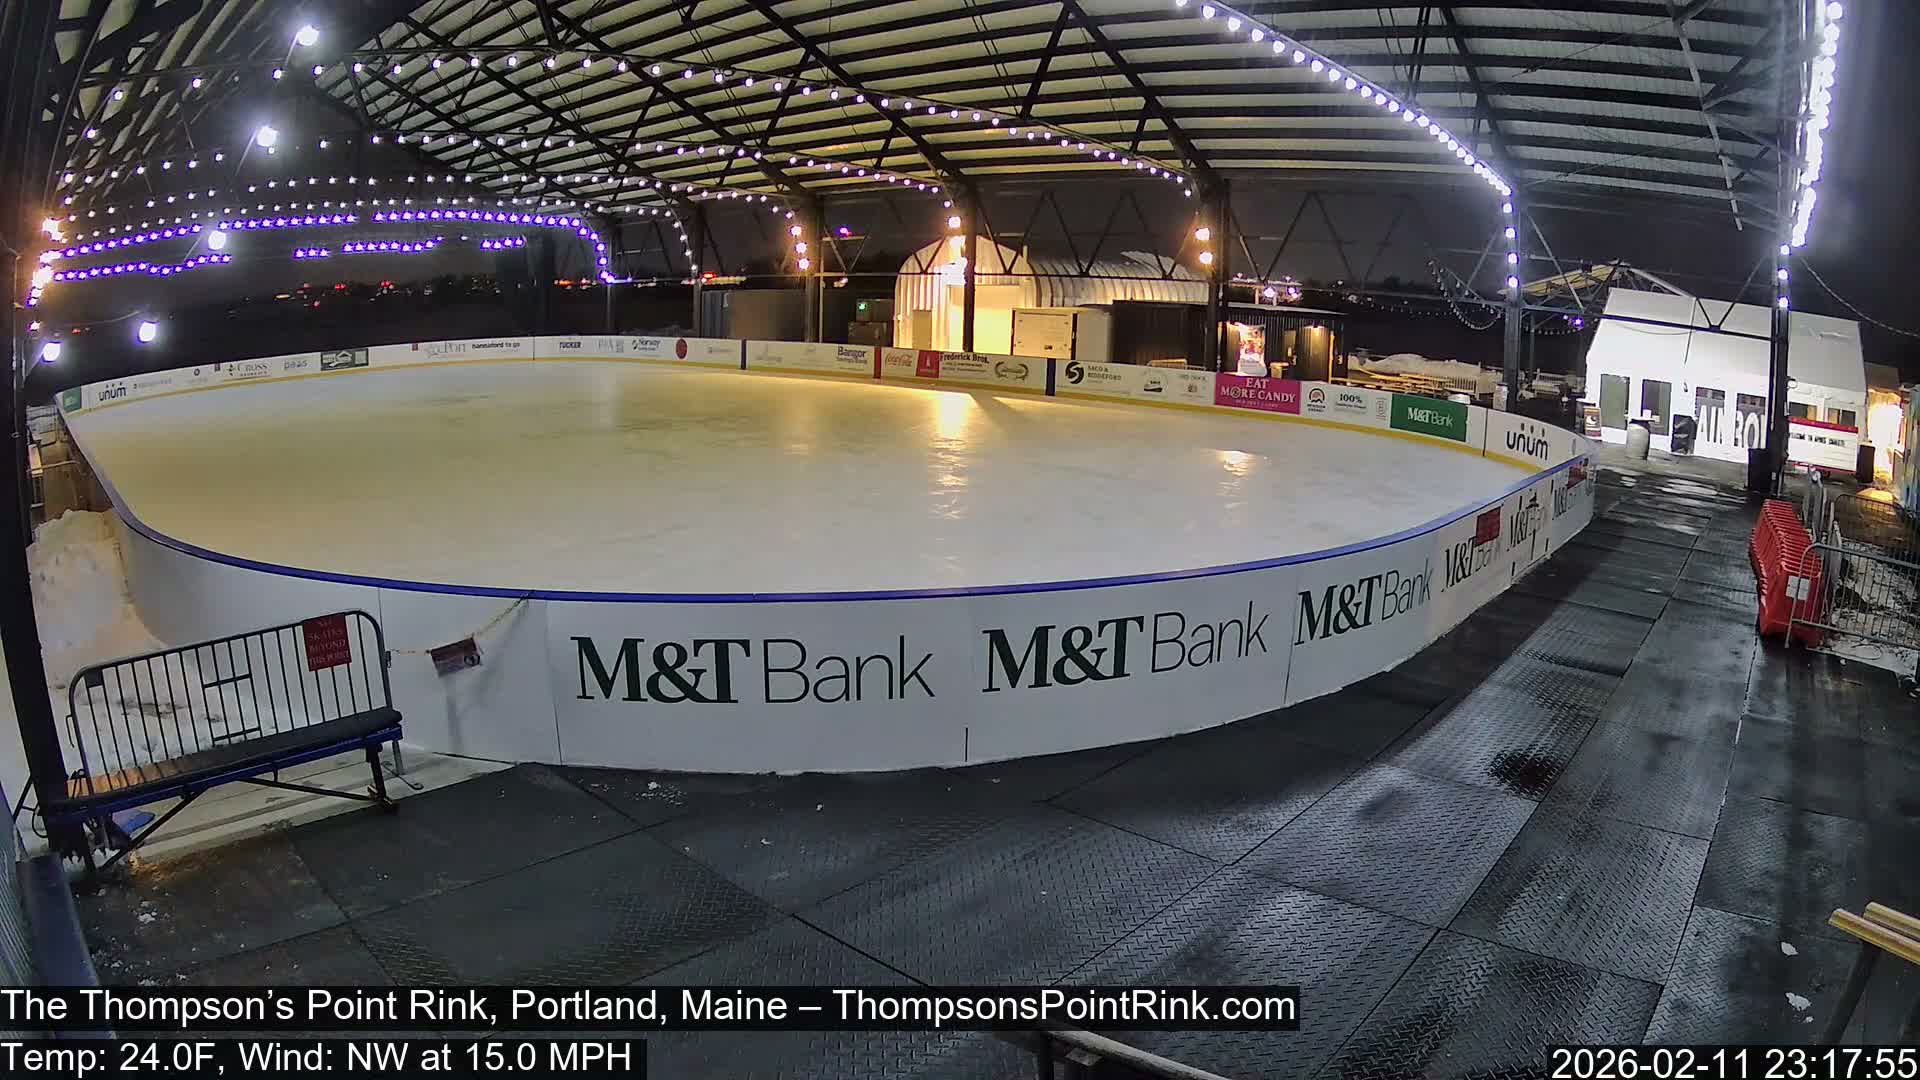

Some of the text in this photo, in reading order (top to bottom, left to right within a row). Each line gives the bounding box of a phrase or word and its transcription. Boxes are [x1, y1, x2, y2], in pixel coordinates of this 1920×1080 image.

[837, 346, 866, 358] Bangor
[940, 352, 971, 361] Frederick
[98, 385, 127, 401] unum
[1246, 378, 1269, 389] EAT
[1220, 385, 1256, 398] MORE
[1257, 390, 1296, 403] CANDY
[1340, 393, 1362, 404] 100%
[1407, 407, 1454, 427] M&T Bank
[1505, 428, 1549, 461] unum
[1441, 536, 1477, 592] M&T
[1294, 557, 1433, 646] M&T Bank
[982, 600, 1269, 693] M&T Bank
[570, 635, 935, 703] M&T Bank
